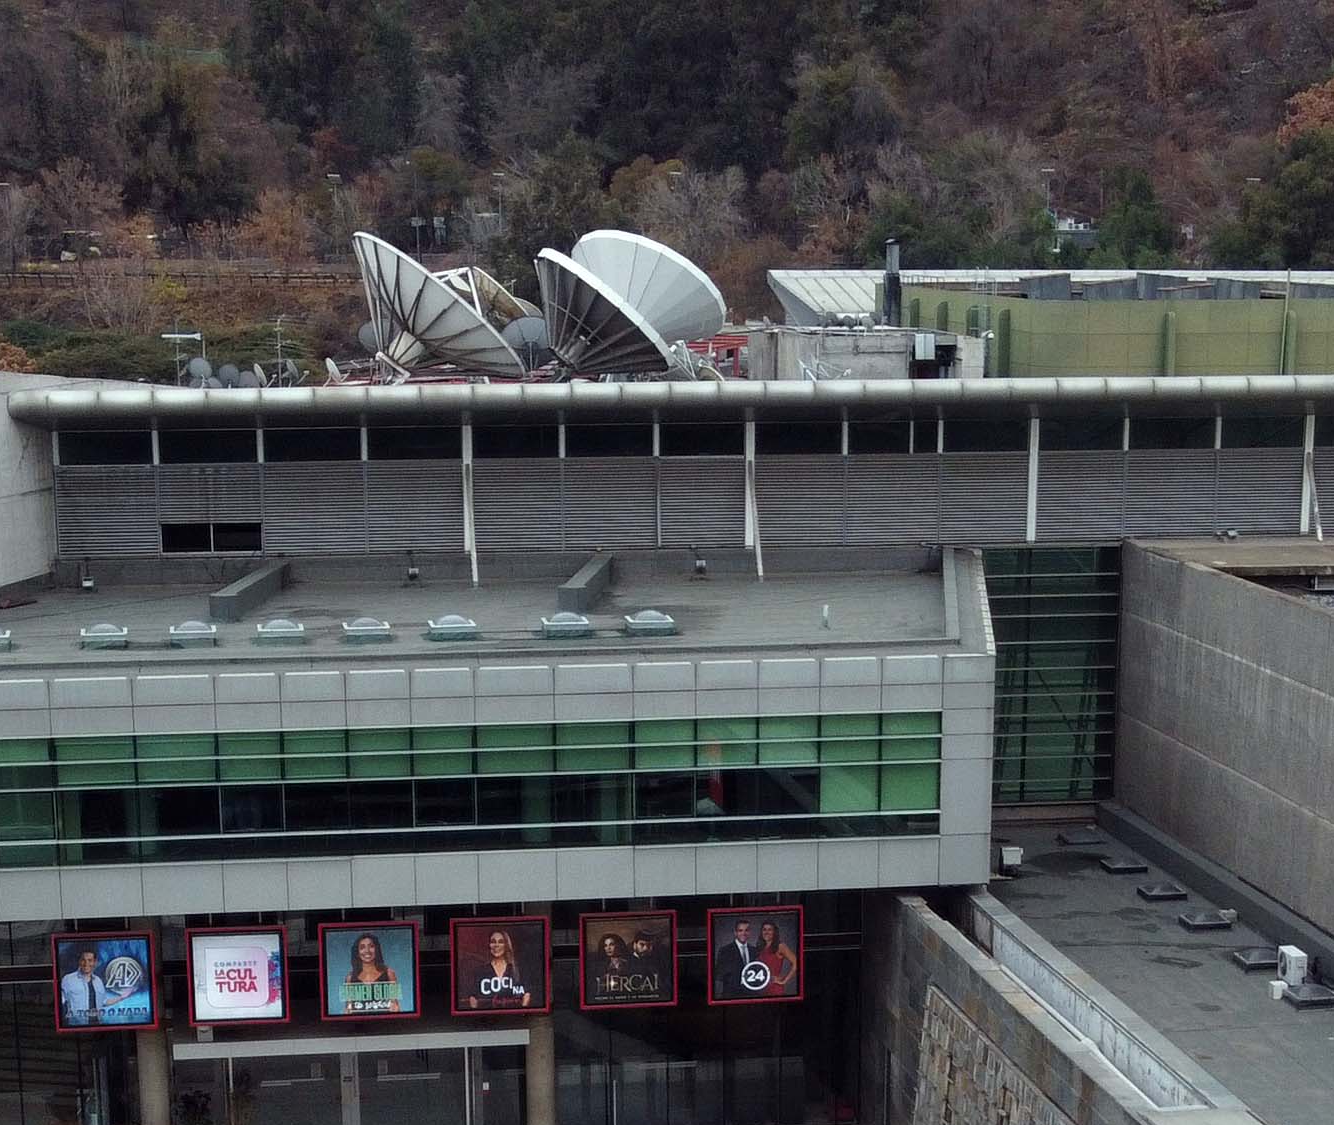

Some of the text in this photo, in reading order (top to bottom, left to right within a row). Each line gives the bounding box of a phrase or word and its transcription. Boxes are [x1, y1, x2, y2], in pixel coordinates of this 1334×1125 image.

[214, 968, 257, 980] LA CUL
[746, 969, 765, 982] 24
[215, 981, 258, 993] TURA
